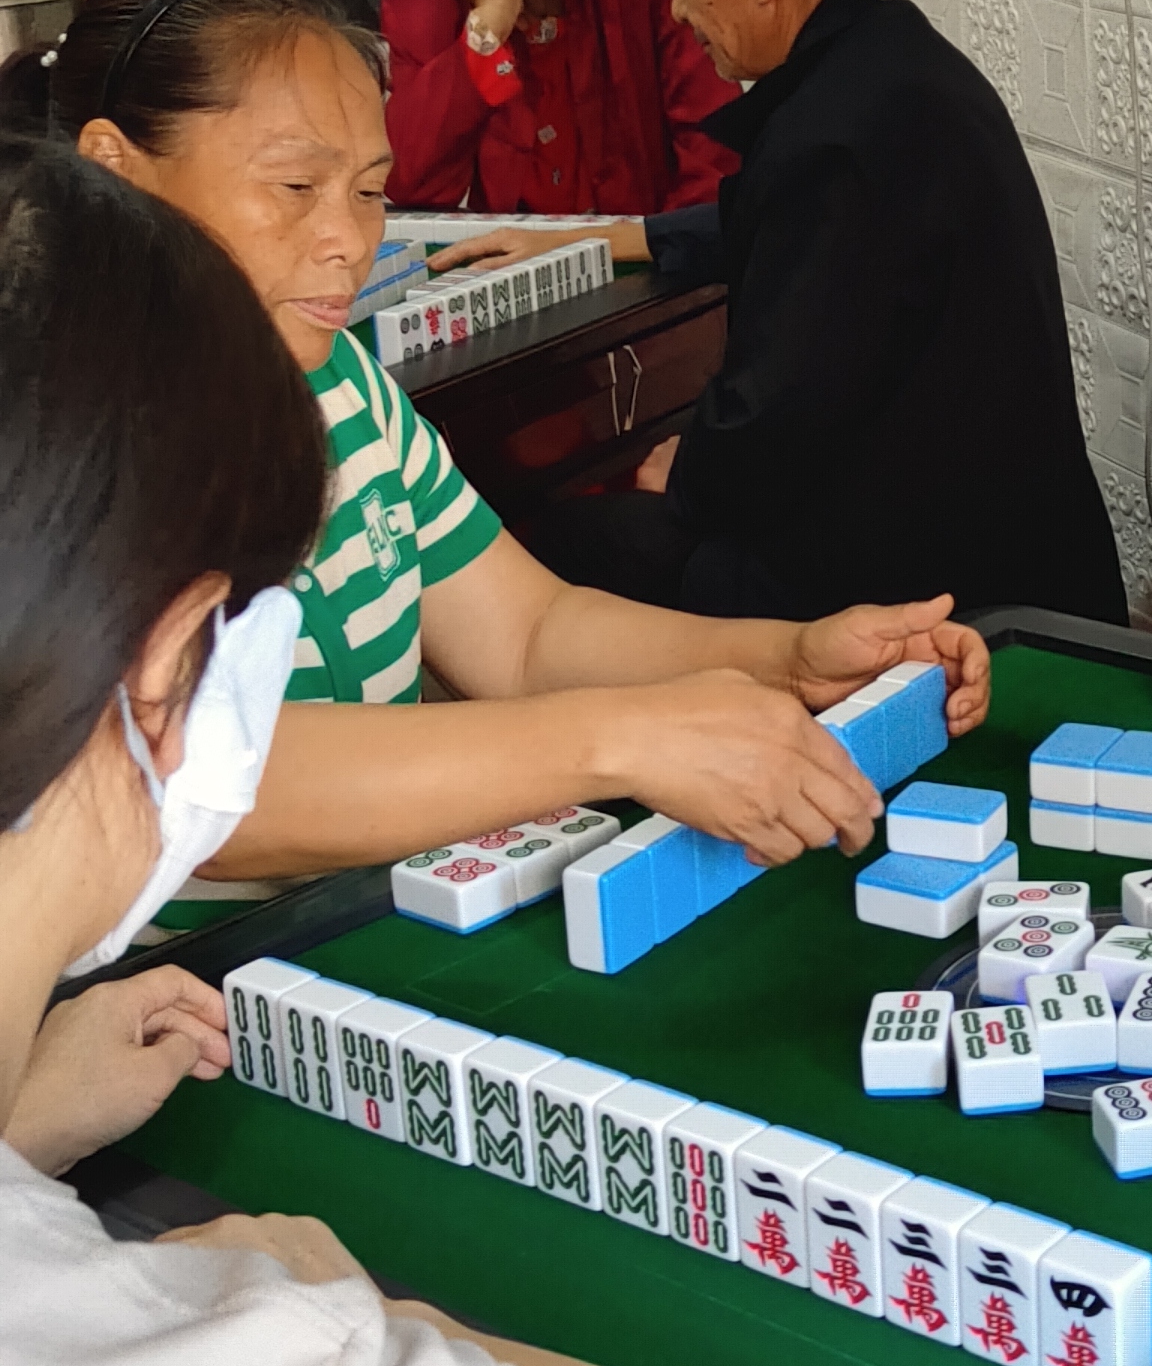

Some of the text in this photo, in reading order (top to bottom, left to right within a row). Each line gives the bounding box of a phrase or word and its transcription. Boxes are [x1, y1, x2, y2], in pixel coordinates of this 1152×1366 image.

[740, 1168, 801, 1276] 二萬
[813, 1196, 872, 1306] 二萬
[888, 1218, 949, 1333] 三萬
[966, 1246, 1030, 1362] 三萬
